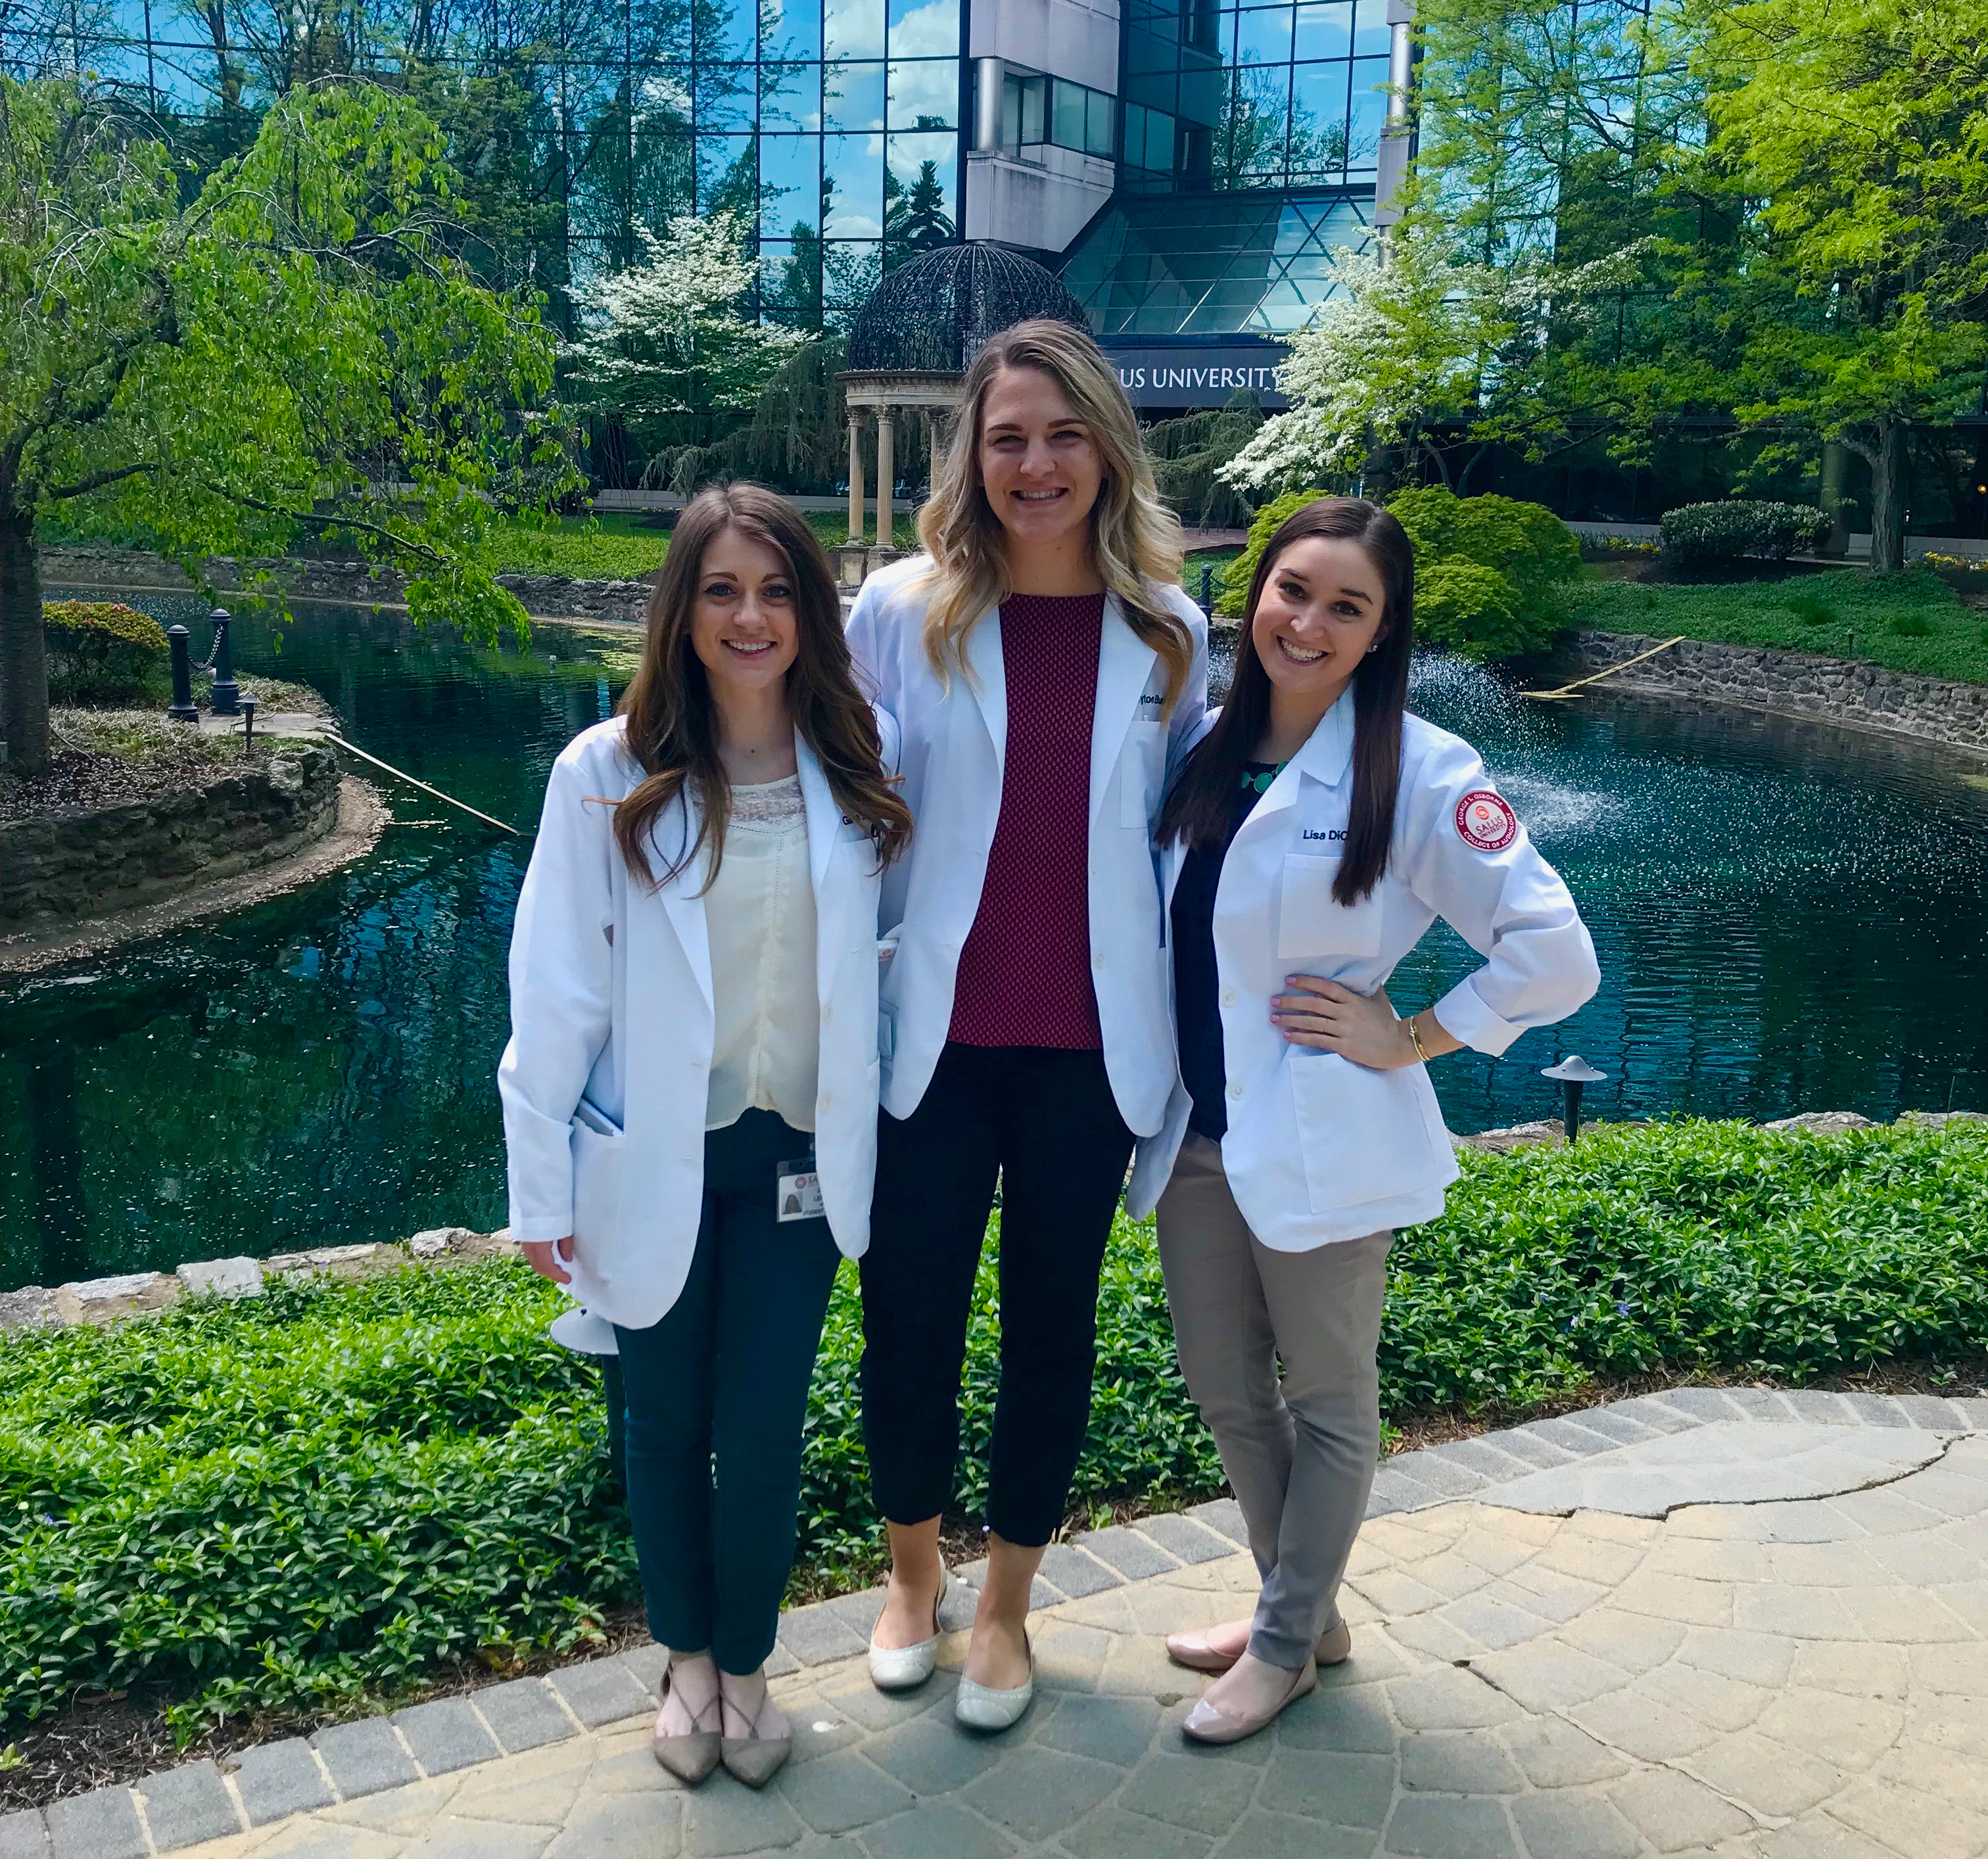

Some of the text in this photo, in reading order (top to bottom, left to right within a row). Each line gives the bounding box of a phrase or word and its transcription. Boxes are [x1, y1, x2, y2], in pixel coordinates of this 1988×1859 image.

[1458, 800, 1469, 826] GEORGE
[1474, 793, 1503, 806] OSBORNE
[1303, 830, 1325, 839] Lisa
[1463, 831, 1490, 848] COLLEGE
[1501, 812, 1514, 845] AUDIOLOGY
[1476, 815, 1503, 835] SALUS
[1480, 823, 1505, 838] UNIVERSITY
